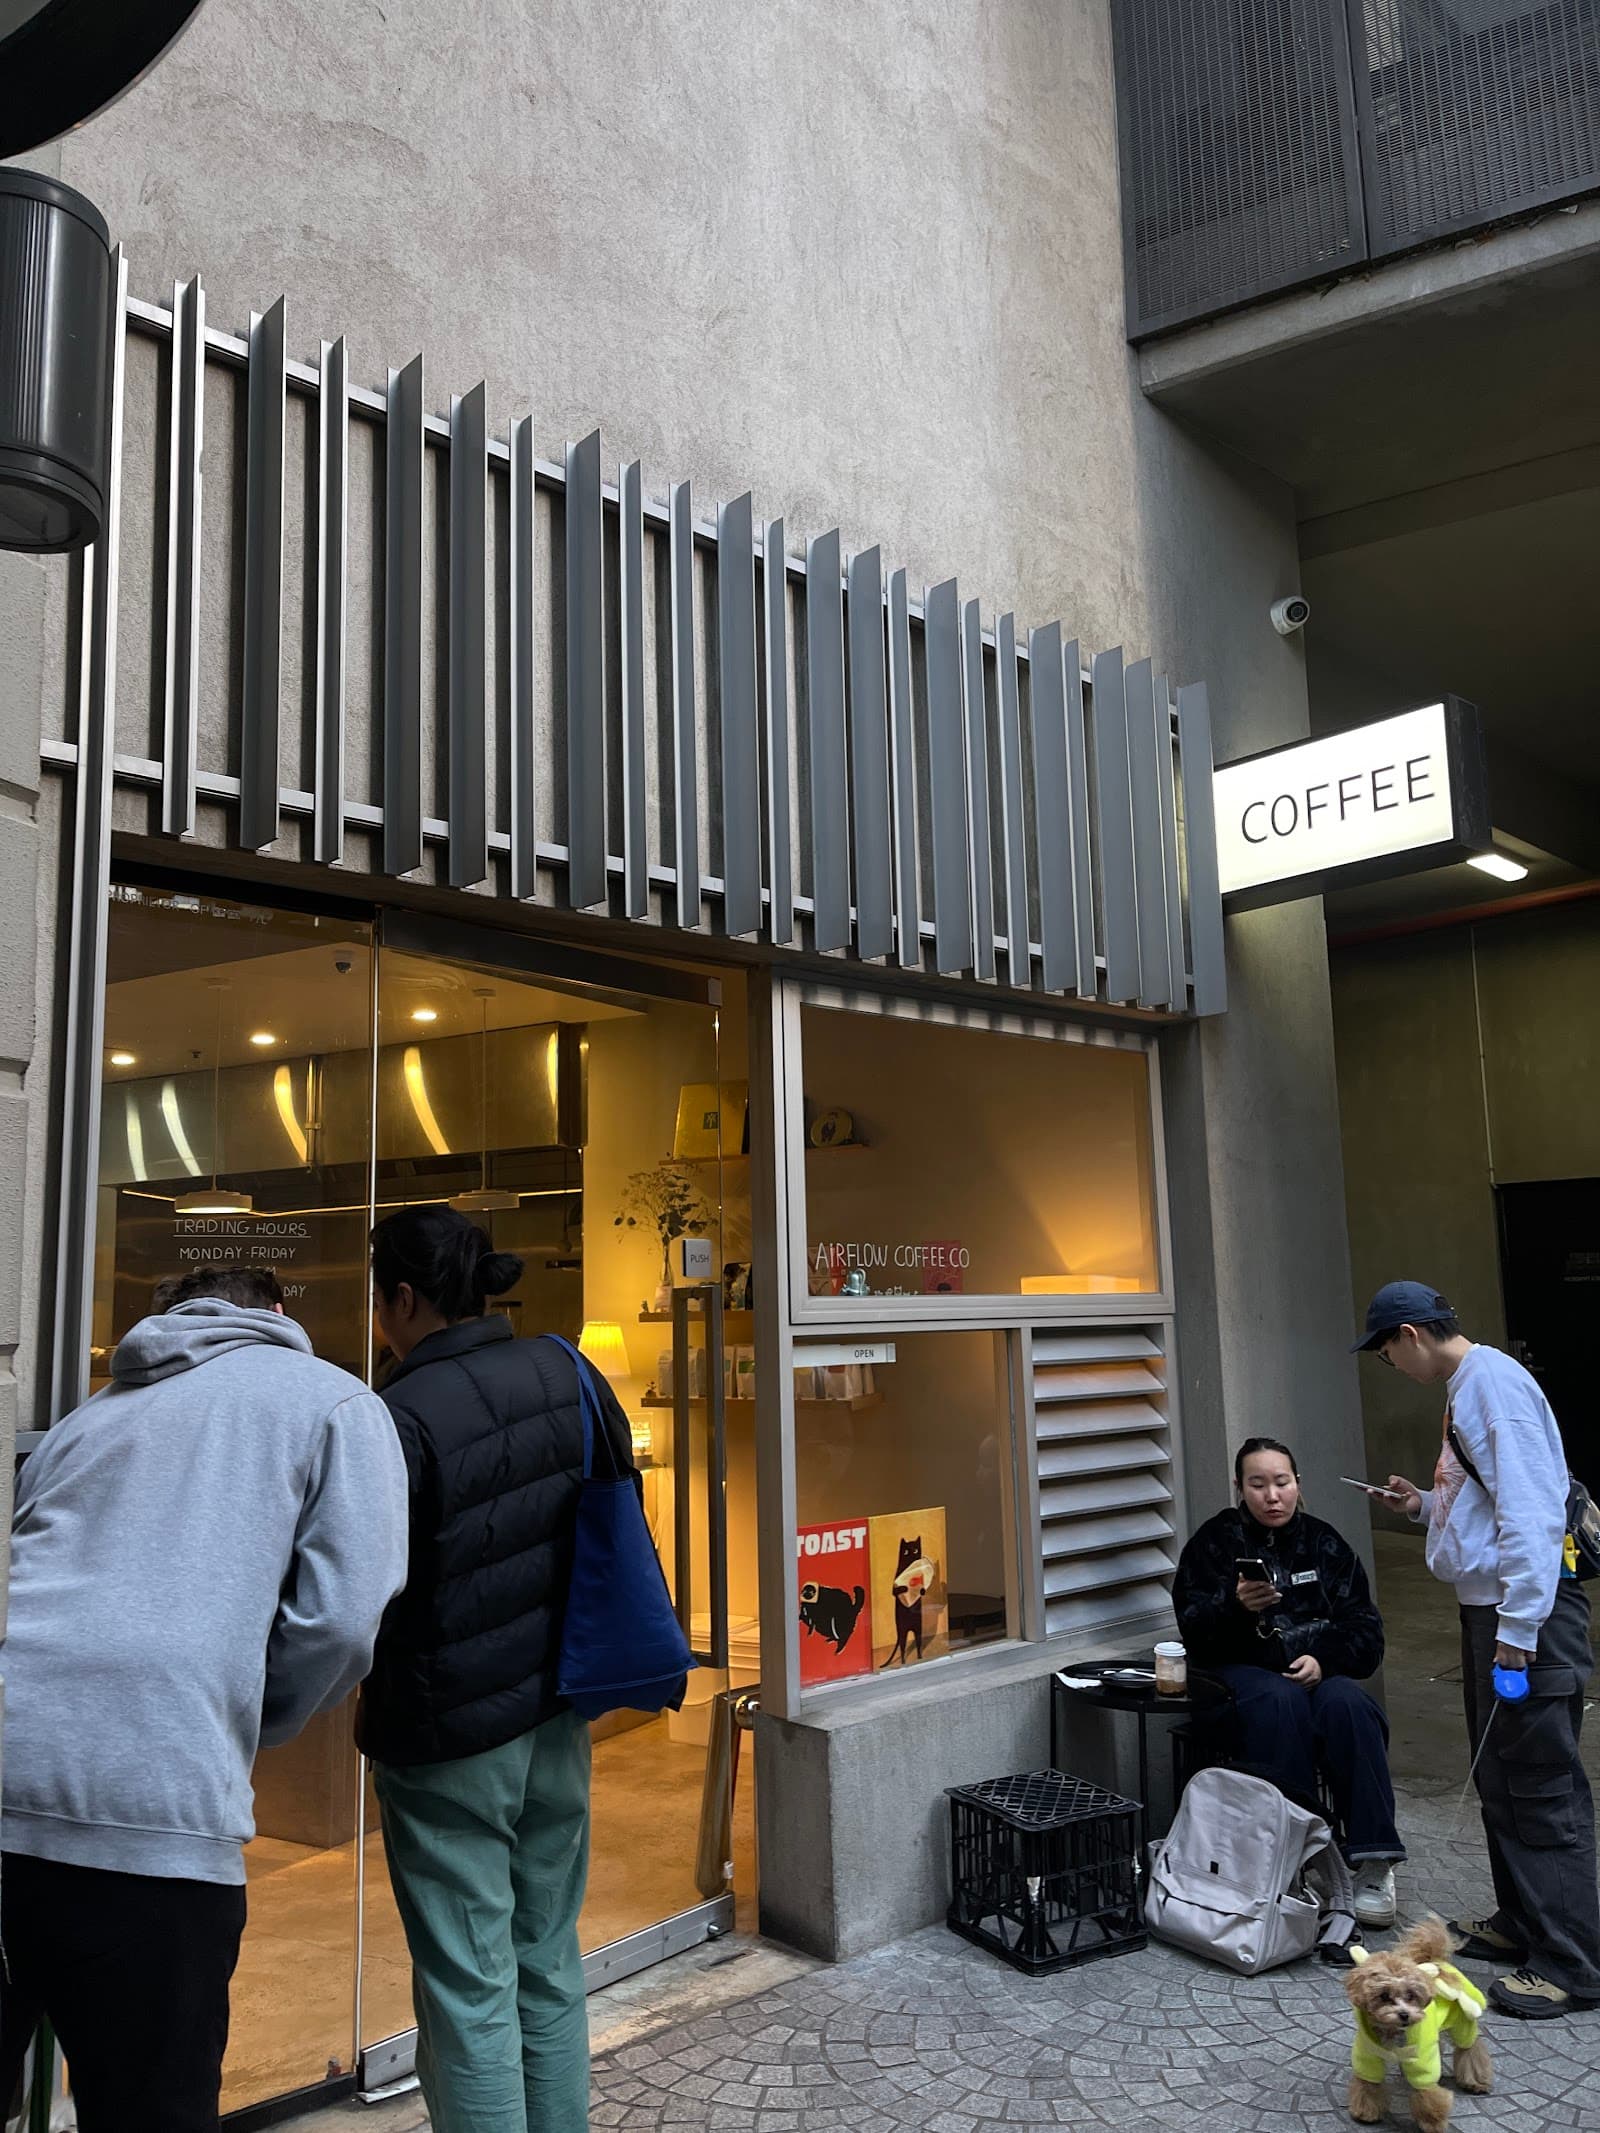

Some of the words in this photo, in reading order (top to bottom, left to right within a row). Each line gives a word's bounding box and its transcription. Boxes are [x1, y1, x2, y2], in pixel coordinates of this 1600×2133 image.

[1241, 755, 1435, 844] COFFEE
[174, 1219, 250, 1234] TRADING
[256, 1222, 307, 1236] HOURS
[179, 1246, 242, 1260] MONDAY
[250, 1246, 296, 1260] FRIDAY
[690, 1254, 710, 1264] PUSH
[894, 1244, 945, 1268] COFFEE
[949, 1247, 970, 1268] CO
[854, 1349, 874, 1358] OPEN
[796, 1527, 867, 1557] TOAST
